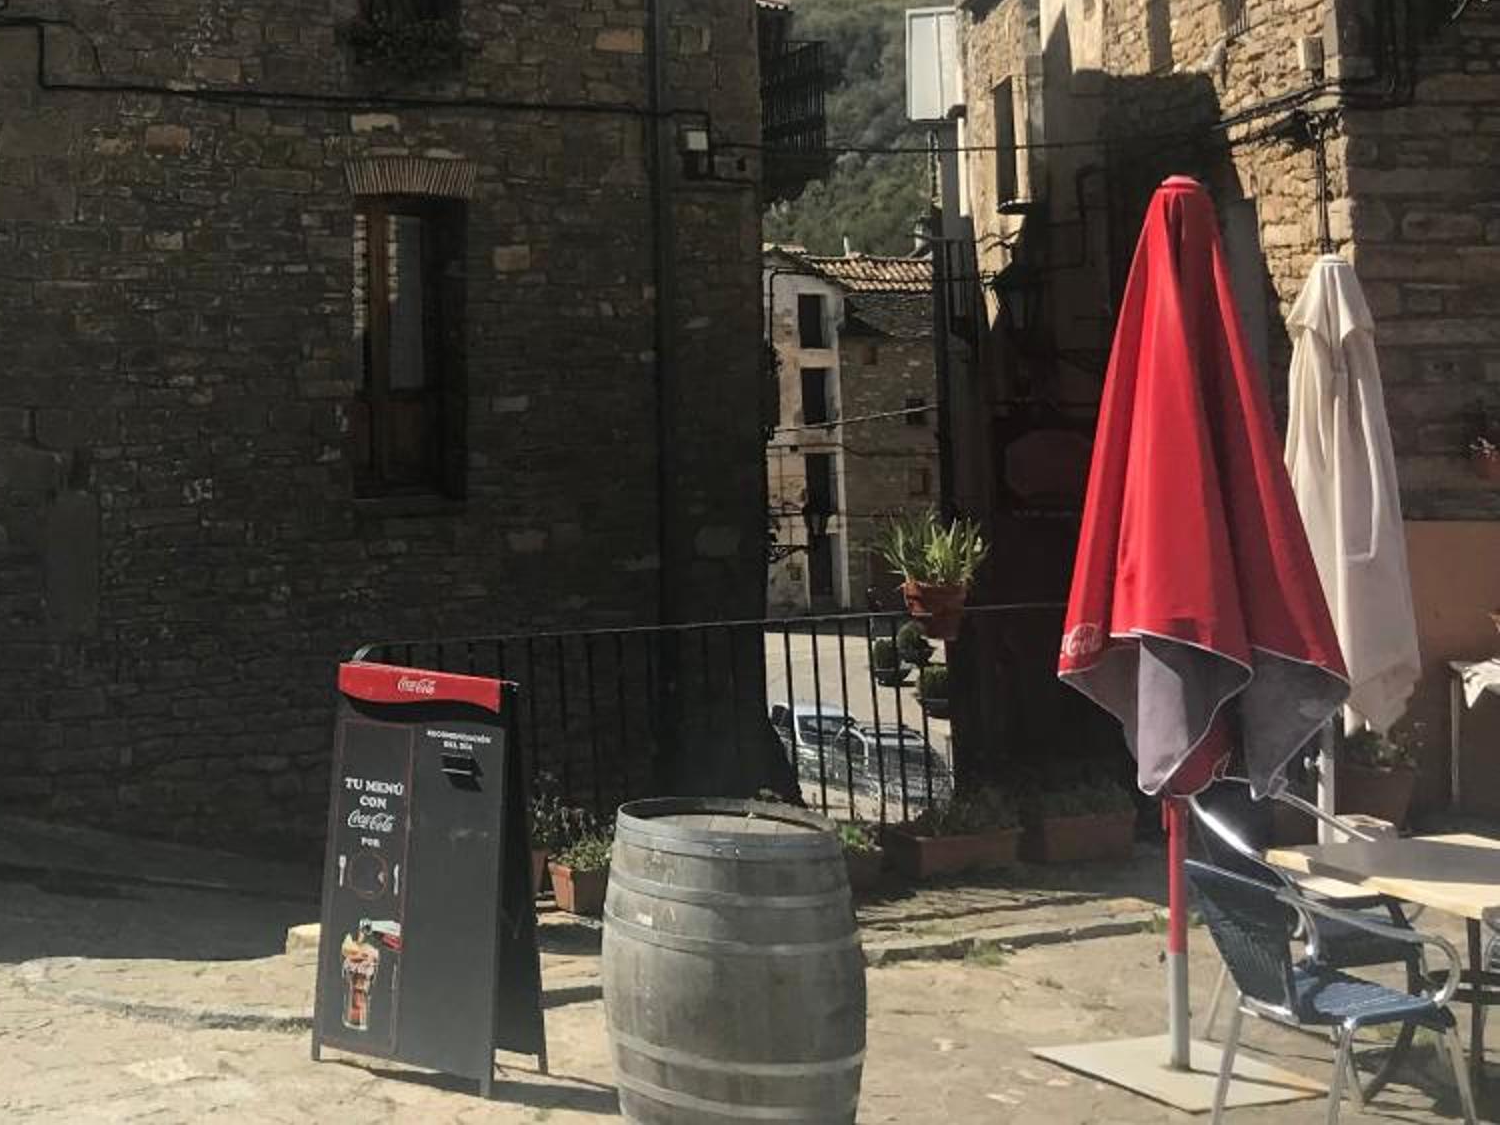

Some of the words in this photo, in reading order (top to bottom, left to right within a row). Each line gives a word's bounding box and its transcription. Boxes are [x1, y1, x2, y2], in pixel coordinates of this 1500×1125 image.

[345, 777, 363, 790] TU
[365, 779, 404, 796] MENÚ
[359, 795, 387, 810] CON
[361, 837, 380, 847] POR
